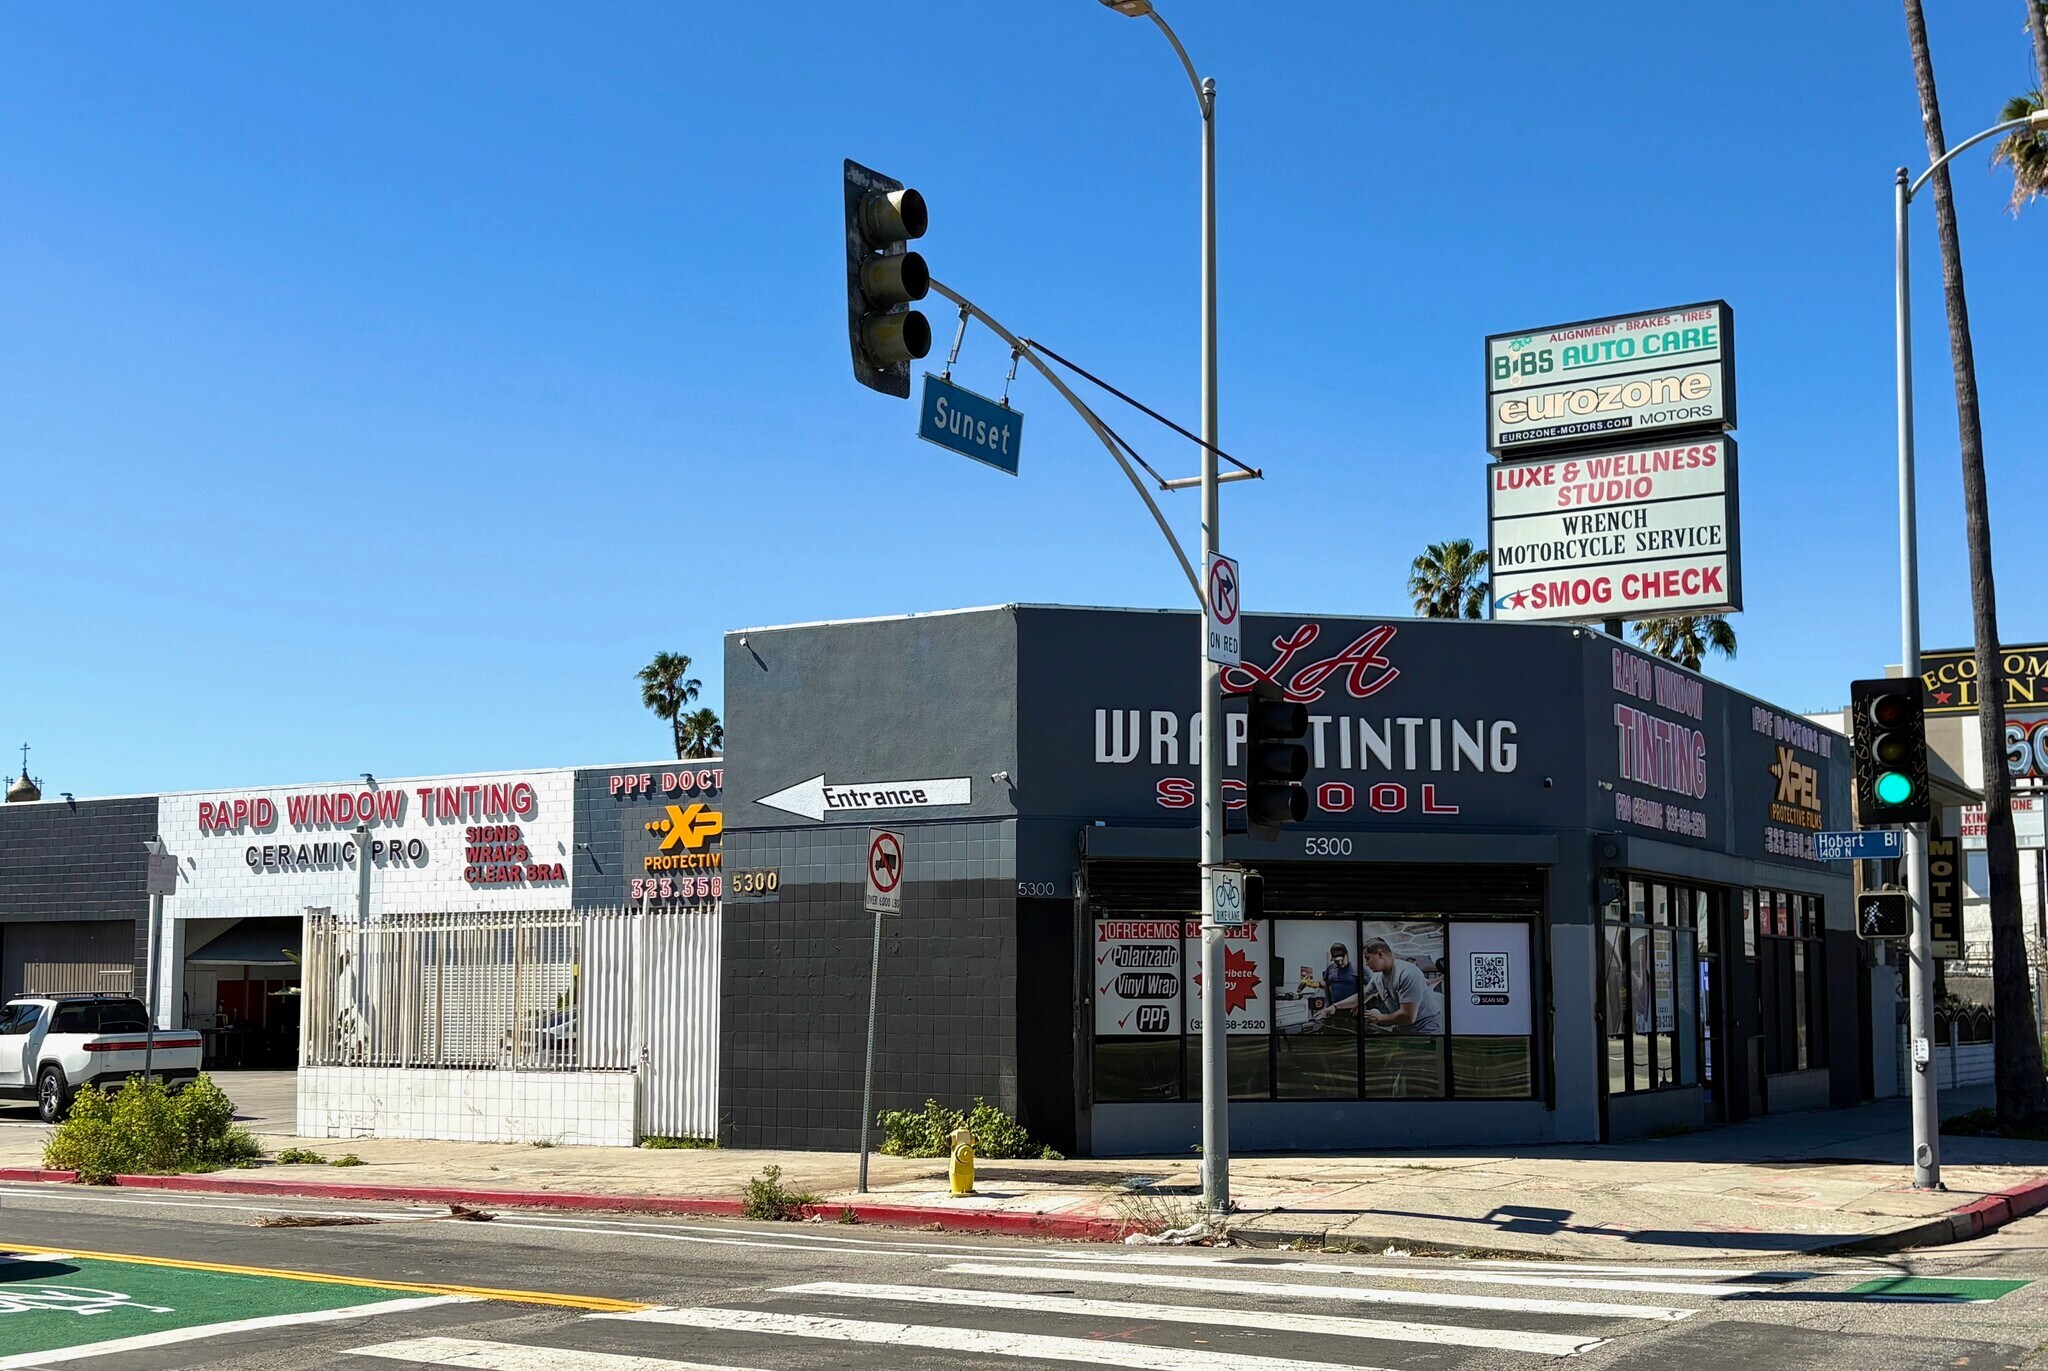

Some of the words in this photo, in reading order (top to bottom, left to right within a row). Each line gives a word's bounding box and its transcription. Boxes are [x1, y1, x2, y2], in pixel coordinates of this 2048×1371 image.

[1550, 324, 1616, 342] ALIGNMENT
[1626, 316, 1670, 331] BRAKES
[1680, 311, 1712, 323] TIRES
[1563, 337, 1635, 366] AUTO
[1643, 325, 1717, 351] CARE
[1499, 372, 1711, 424] eurozone
[934, 397, 1009, 454] Sunset
[1502, 418, 1630, 442] EUROZONE-MOTORS.COM
[1640, 406, 1712, 425] MOTORS
[1496, 465, 1555, 491] LUXE
[1563, 462, 1580, 483] &
[1586, 445, 1716, 479] WELLNESS
[1558, 477, 1652, 506] STUDIO
[1562, 509, 1648, 536] WRENCH
[1498, 535, 1625, 566] MOTORCYCLE
[1636, 526, 1721, 552] SERVICE
[1531, 578, 1611, 609] SMOG
[1621, 566, 1723, 599] CHECK
[1210, 632, 1220, 648] ON
[1223, 636, 1238, 654] RED
[1220, 623, 1400, 704] LA
[1920, 655, 2048, 691] ECOOM
[1612, 648, 1651, 701] RAPID
[1654, 666, 1703, 720] WINDOW
[1957, 677, 2036, 705] IN
[1308, 715, 1518, 773] TINTING
[1614, 703, 1707, 800] TINTING
[610, 775, 651, 794] PPF
[1777, 746, 1821, 812] XPEL
[199, 798, 274, 830] RAPID
[286, 789, 403, 825] WINDOW
[417, 783, 533, 818] TINTING
[822, 788, 927, 809] Entrance
[1156, 777, 1460, 815] SCOOL
[466, 825, 519, 842] SIGNS
[1305, 837, 1352, 856] 5300
[1819, 834, 1864, 847] Hobart
[1884, 833, 1897, 846] Bl
[246, 840, 355, 867] CERAMIC
[371, 838, 423, 862] PRO
[465, 845, 527, 863] WRAPS
[644, 853, 722, 870] PROTECTIV
[1820, 848, 1840, 858] 1400
[1845, 847, 1852, 857] N
[464, 865, 521, 884] CLEAR
[526, 863, 564, 881] BRA
[732, 870, 778, 893] 5300
[1018, 882, 1054, 896] 5300
[1929, 841, 1953, 938] MOTEL
[1107, 924, 1180, 938] OFRECEMOS
[1113, 946, 1177, 967] Polarizado
[1117, 975, 1145, 997] Vinyl
[1148, 977, 1177, 997] Wrap
[1224, 981, 1237, 991] oy
[1139, 1008, 1167, 1029] PPF
